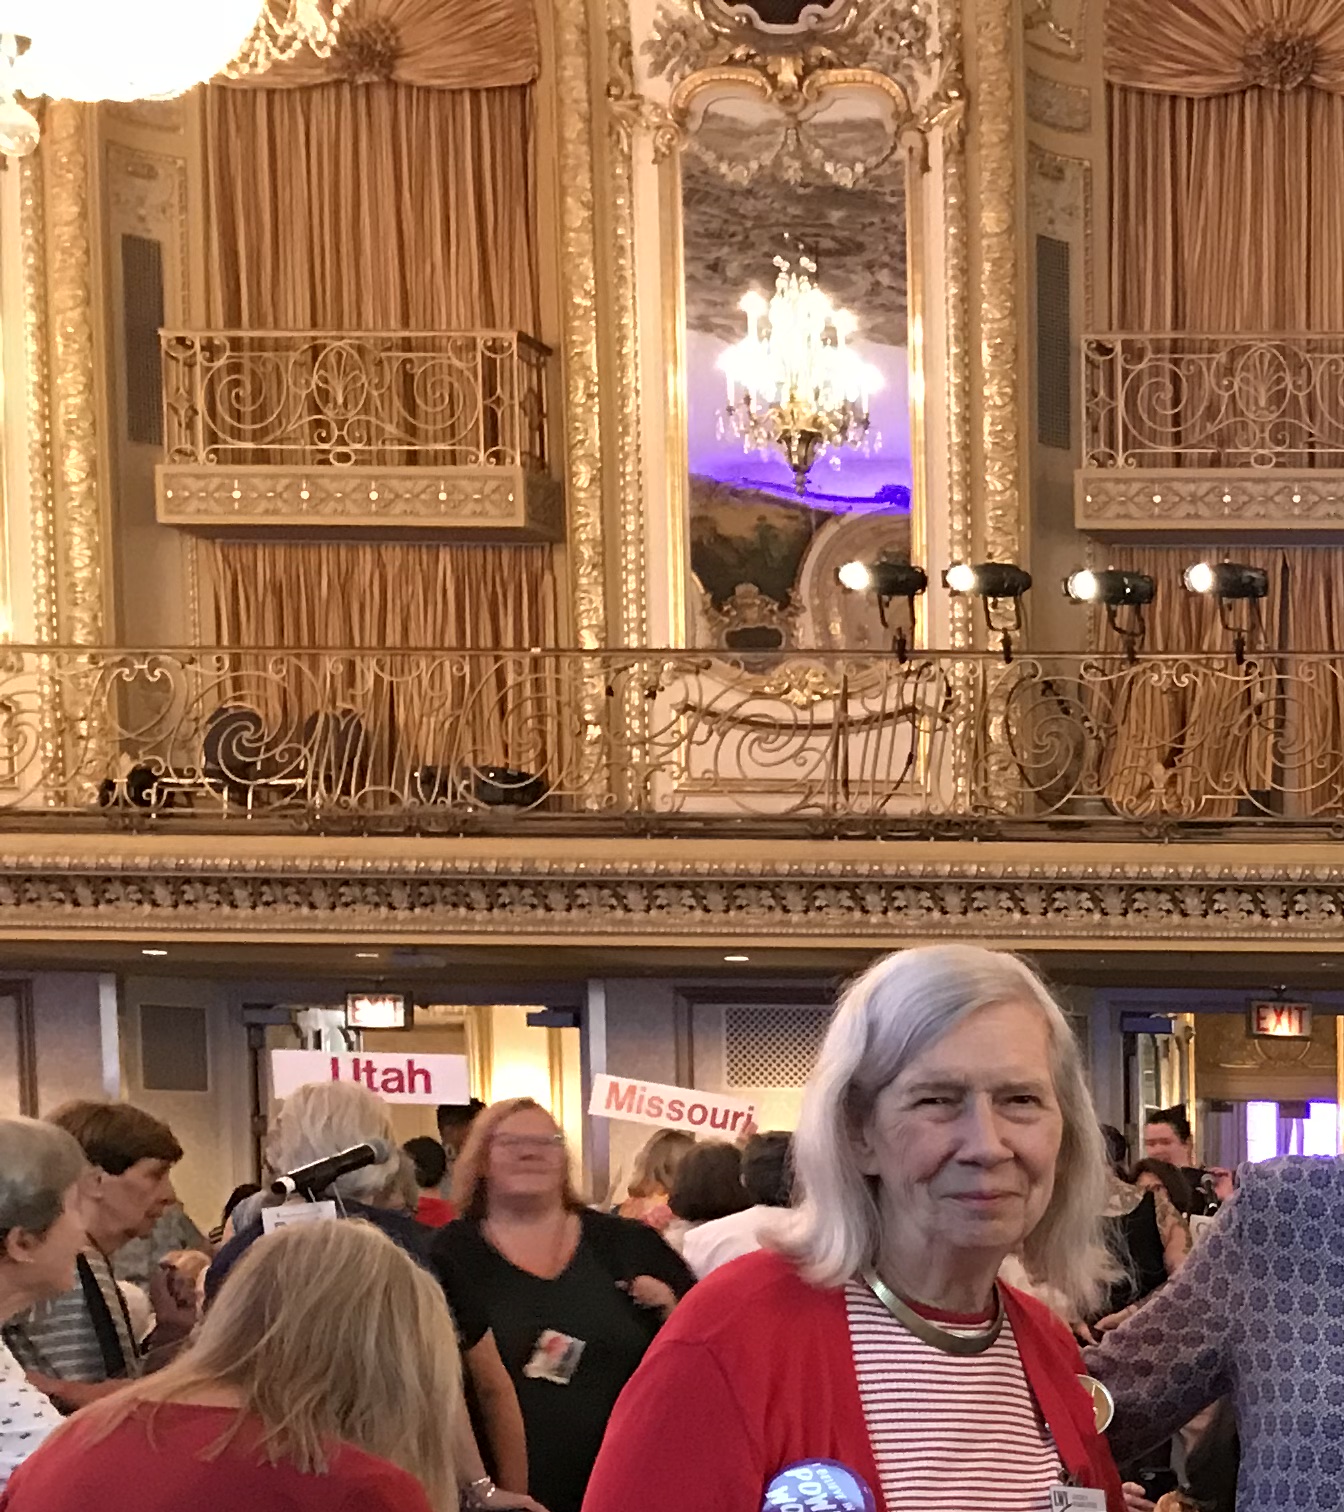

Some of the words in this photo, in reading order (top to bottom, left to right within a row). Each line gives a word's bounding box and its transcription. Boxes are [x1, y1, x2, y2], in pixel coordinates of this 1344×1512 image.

[351, 995, 402, 1024] ET
[1256, 1005, 1307, 1033] EXIT
[331, 1056, 431, 1094] Utah
[605, 1081, 755, 1134] Missouri
[816, 1469, 847, 1500] BELIEVE
[842, 1502, 856, 1511] IN
